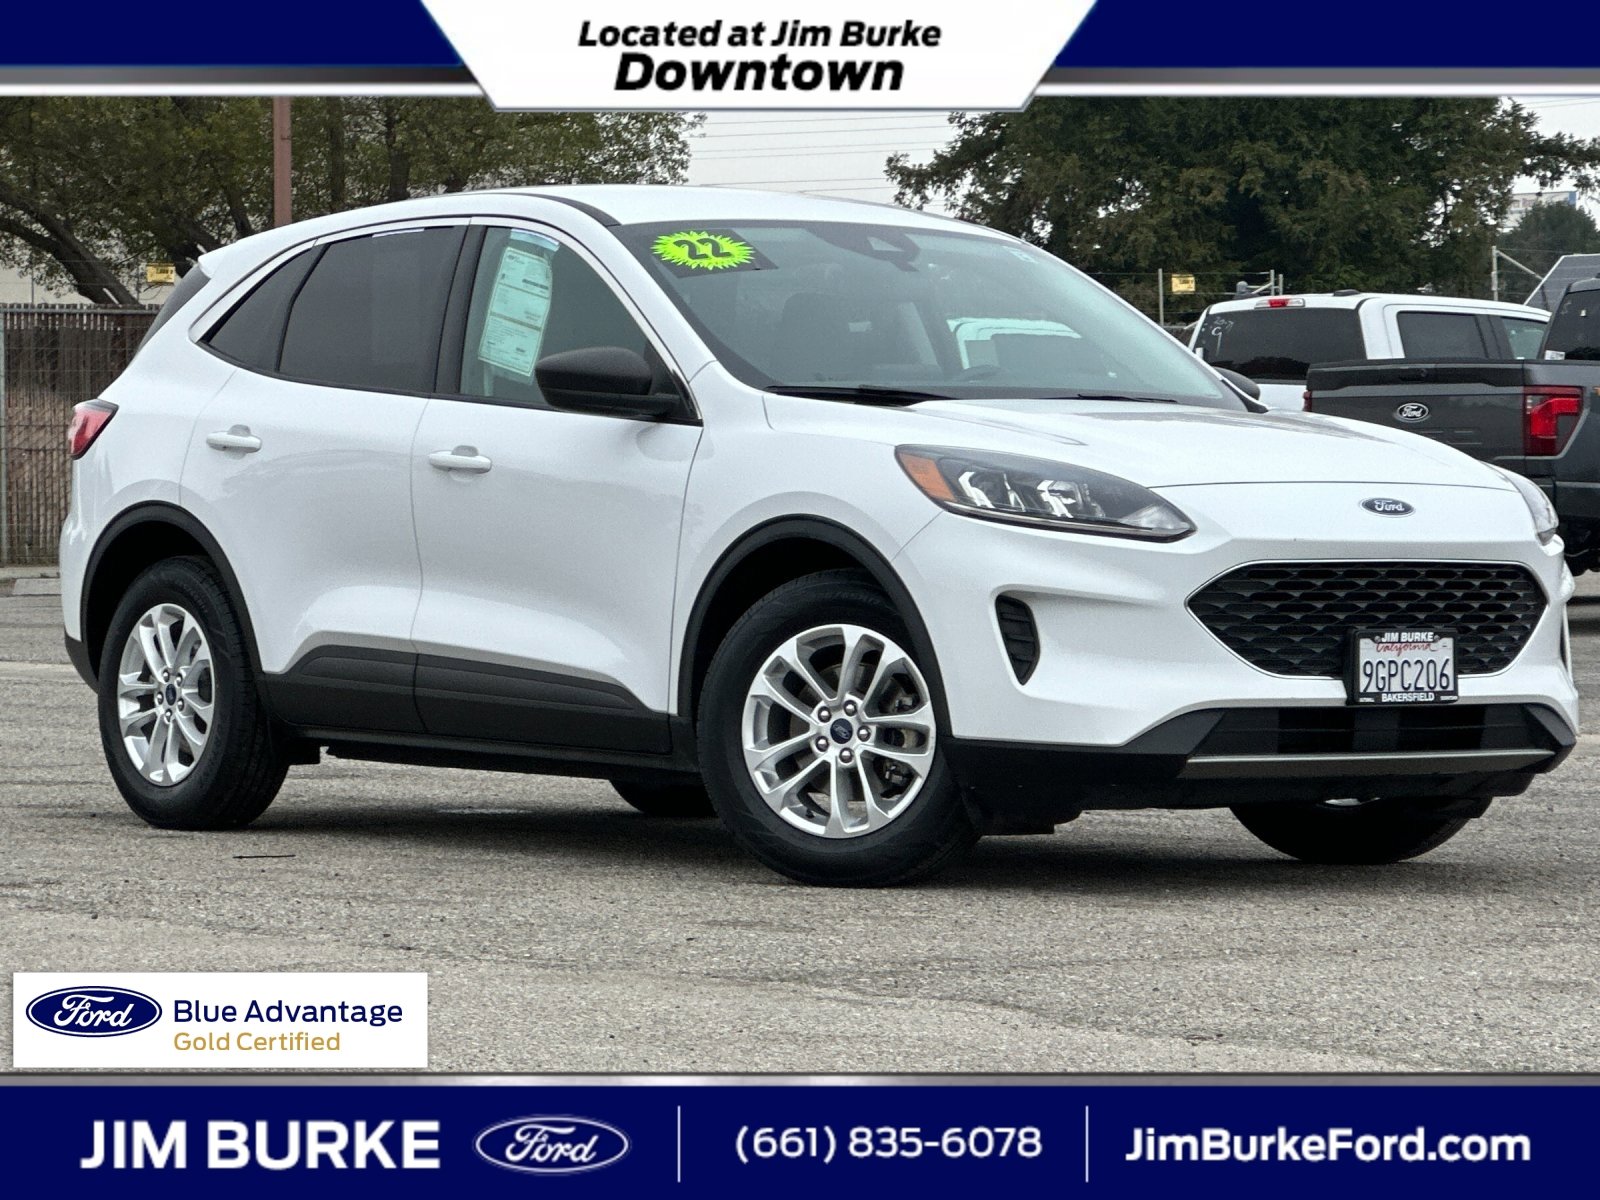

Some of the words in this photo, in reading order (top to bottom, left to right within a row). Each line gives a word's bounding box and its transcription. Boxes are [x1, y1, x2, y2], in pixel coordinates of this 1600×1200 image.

[673, 238, 735, 260] 22
[1401, 405, 1423, 417] Ford
[1373, 499, 1405, 512] Ford
[1381, 632, 1399, 642] JIM
[1400, 632, 1434, 642] BURKE
[1363, 658, 1450, 692] 9GPC206
[1381, 693, 1434, 702] BAKERSFIELD
